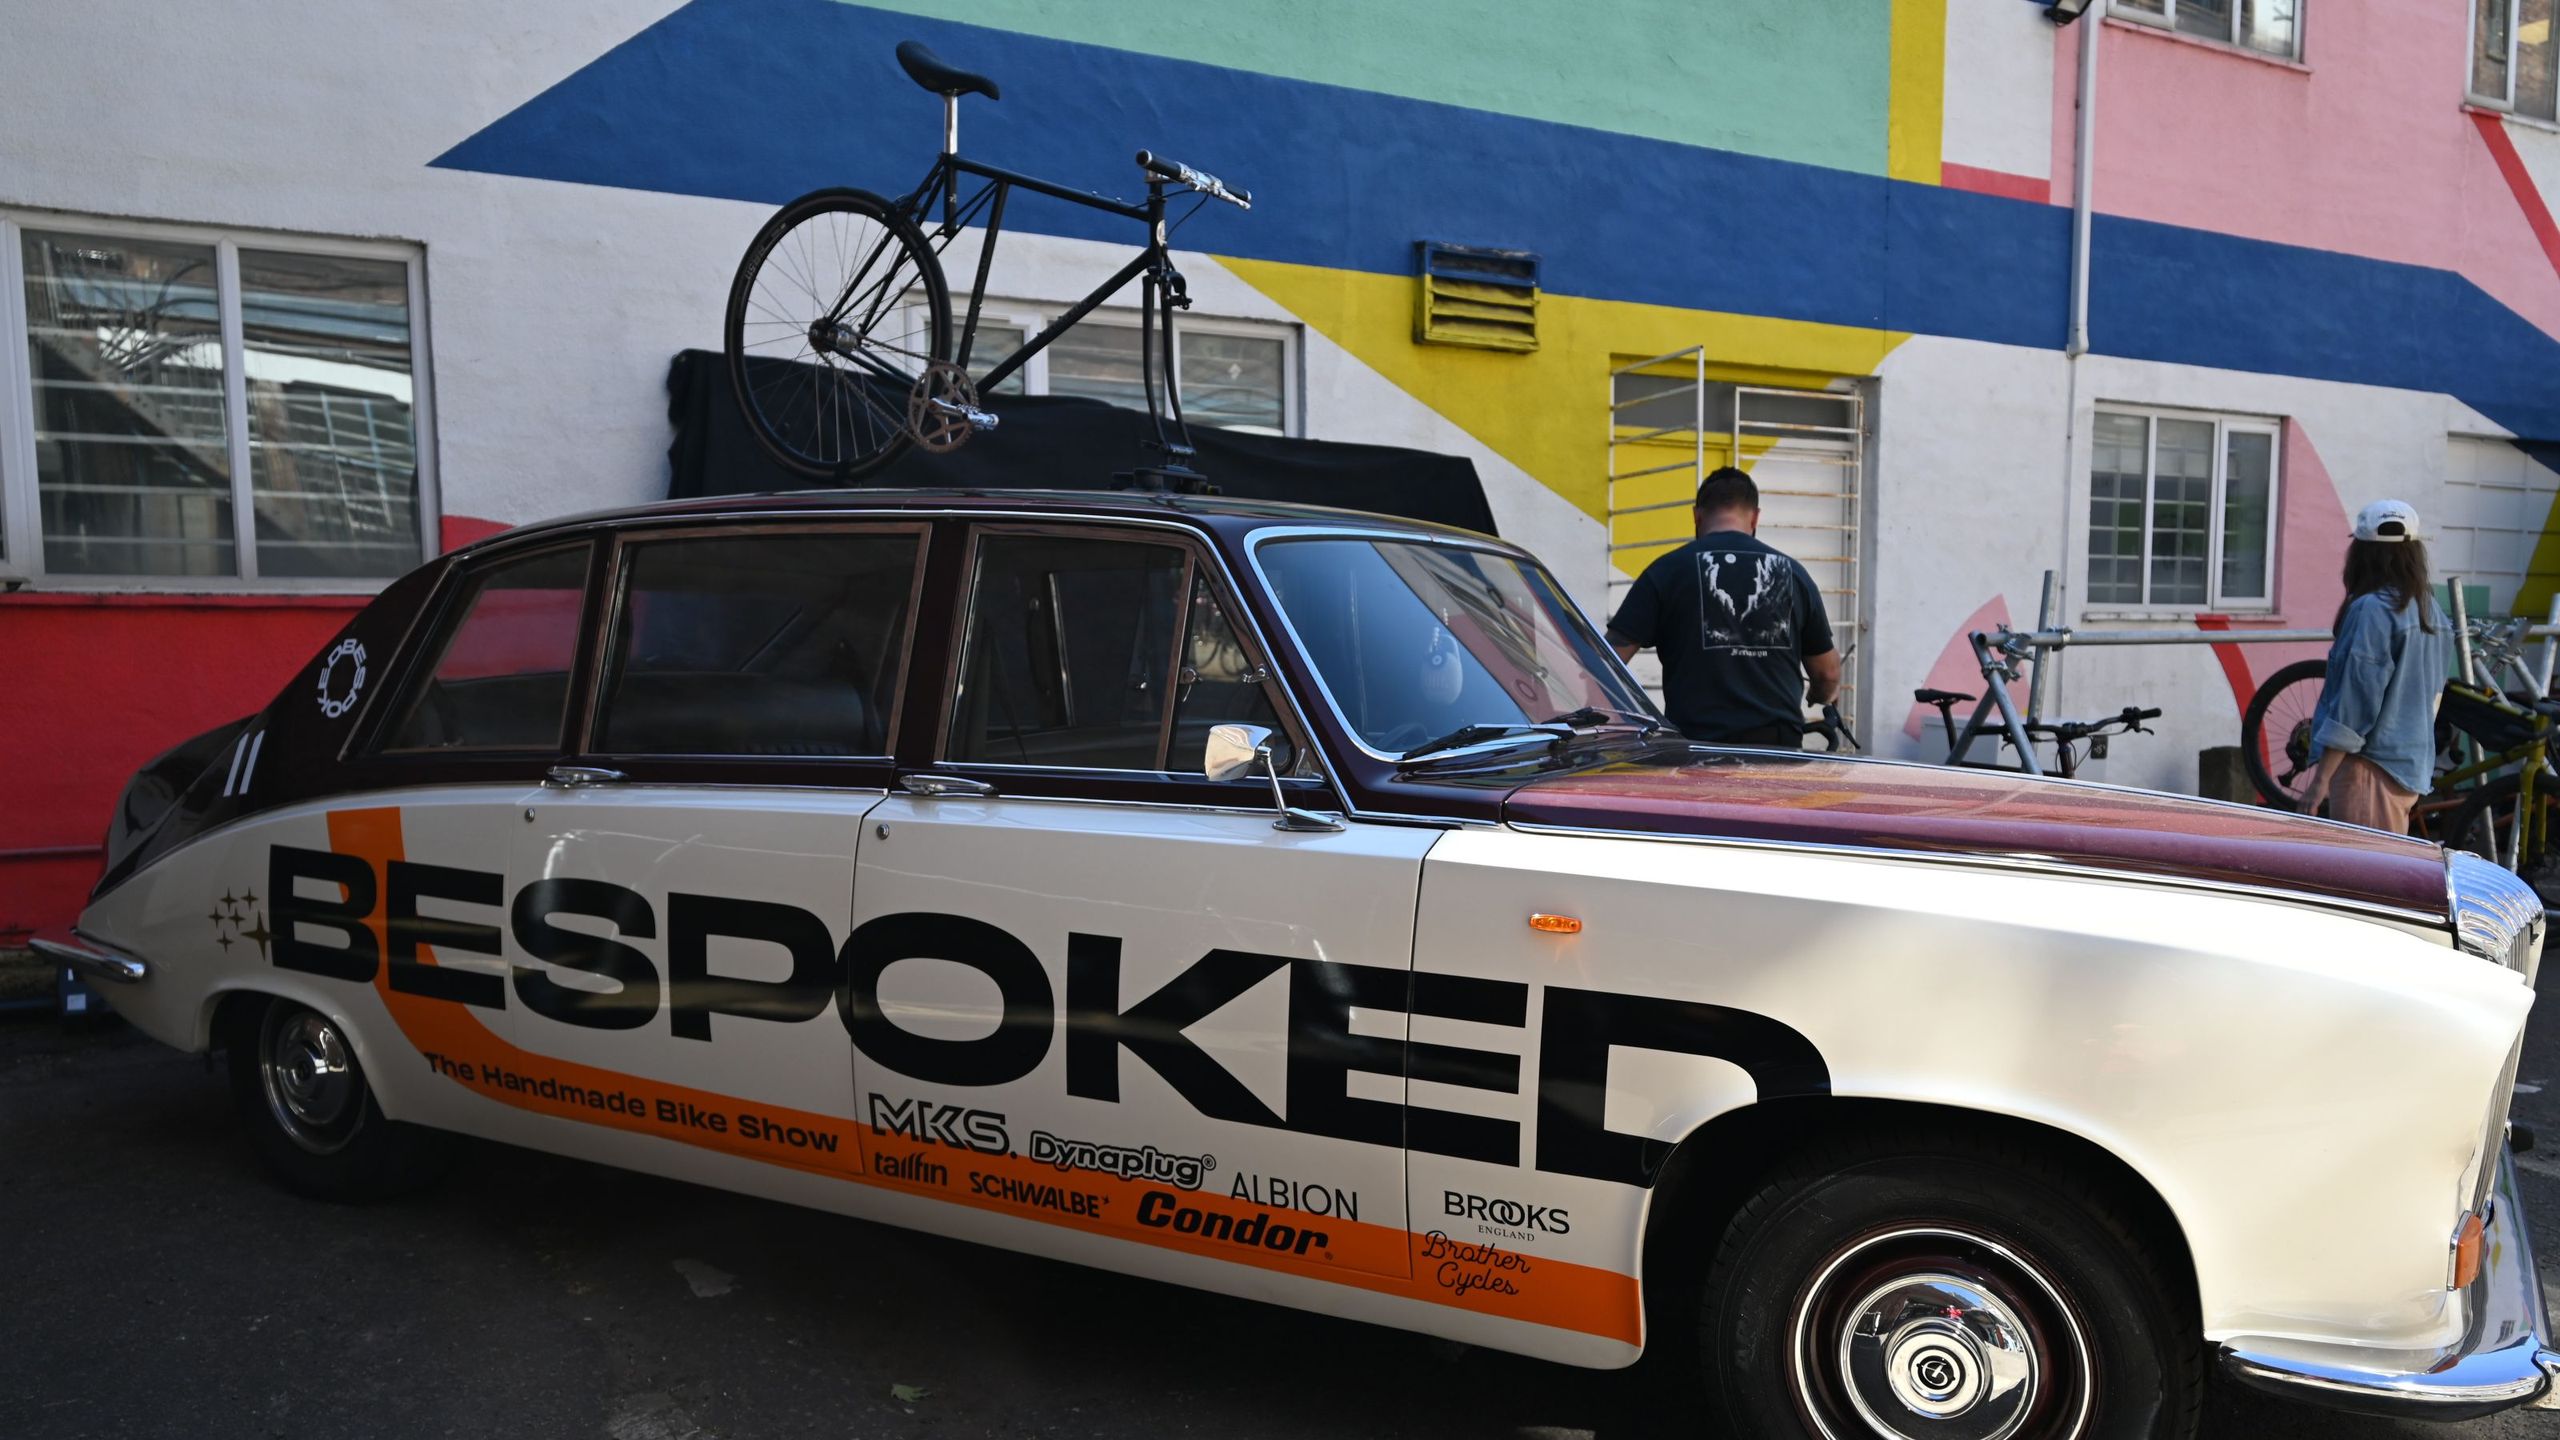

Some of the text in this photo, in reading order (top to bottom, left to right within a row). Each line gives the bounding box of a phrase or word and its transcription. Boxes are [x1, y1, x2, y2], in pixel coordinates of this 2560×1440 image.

[268, 844, 1832, 1189] BESPOKED
[423, 1052, 838, 1152] The Handmade Bike Show
[873, 1151, 948, 1187] tailfin
[969, 1171, 1101, 1218] SCHWALBE
[1230, 1171, 1358, 1222] ALBION
[1443, 1190, 1571, 1235] BROOKS
[1422, 1230, 1531, 1274] Brother
[1478, 1224, 1536, 1242] ENGLAND
[1437, 1261, 1520, 1297] Cycles
